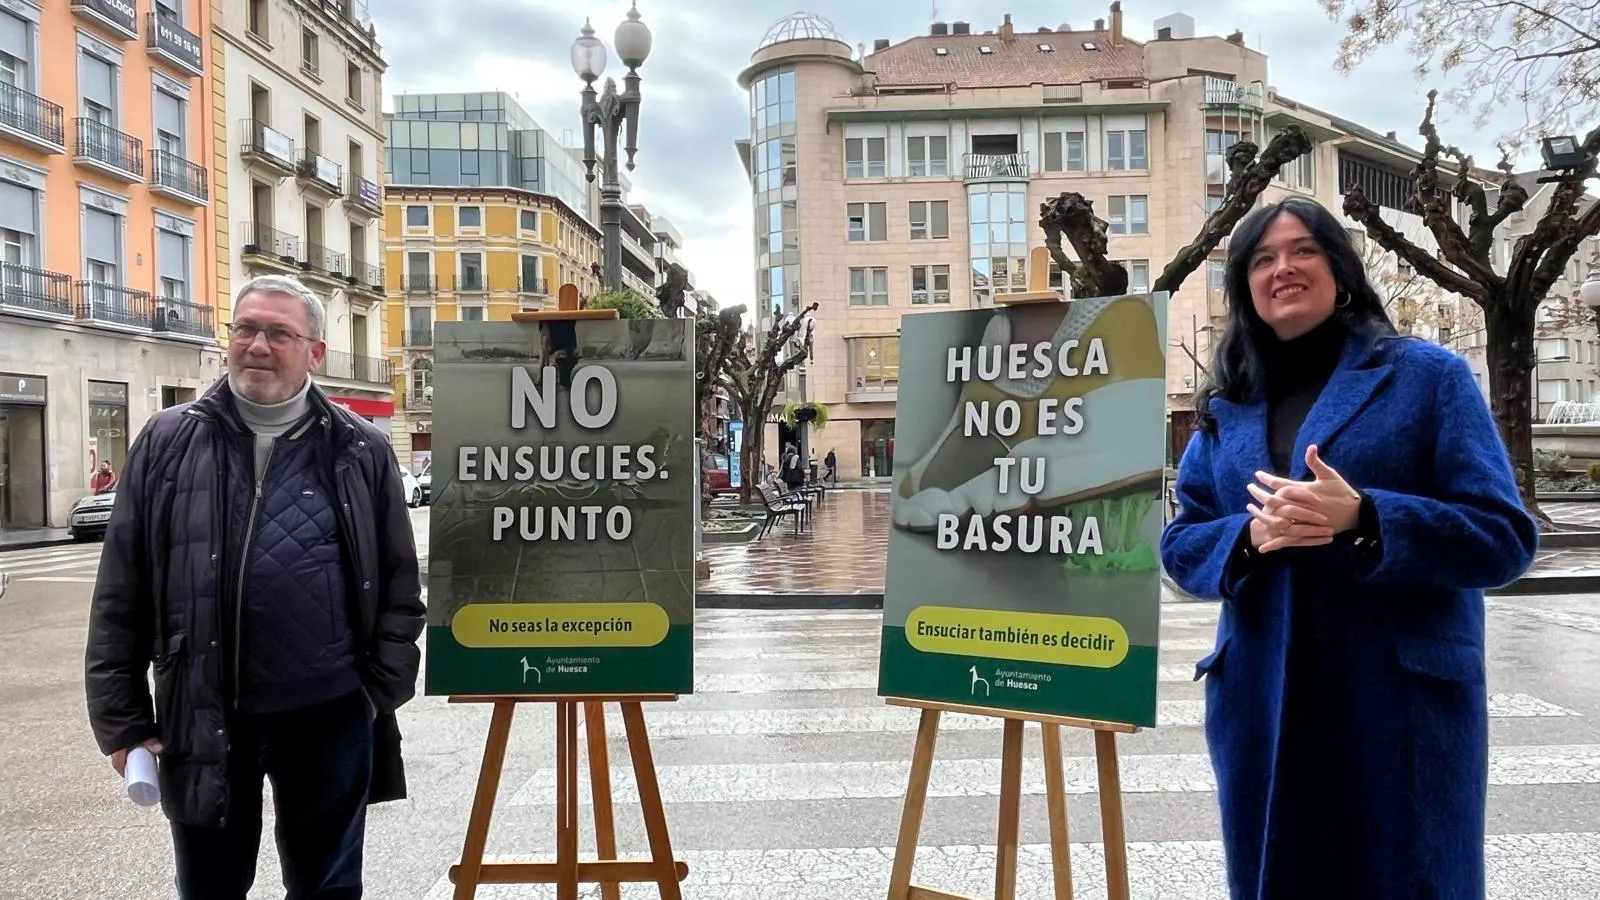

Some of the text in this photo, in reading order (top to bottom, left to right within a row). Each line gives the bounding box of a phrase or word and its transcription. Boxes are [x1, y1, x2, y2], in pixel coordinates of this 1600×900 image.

[946, 338, 1109, 382] HUESCA
[511, 365, 618, 429] NO
[963, 397, 1084, 437] NO ES
[458, 445, 669, 482] ENSUCIES.
[994, 457, 1046, 495] TU
[492, 505, 632, 541] PUNTO
[936, 513, 1104, 556] BASURA
[489, 617, 632, 636] No seas la excepción
[917, 621, 1115, 651] Ensuciar también es decidir
[546, 656, 601, 665] Ayuntamiento
[546, 665, 588, 673] de Huesca
[995, 668, 1052, 682] Ayuntamiento
[994, 678, 1038, 691] de Huesca
